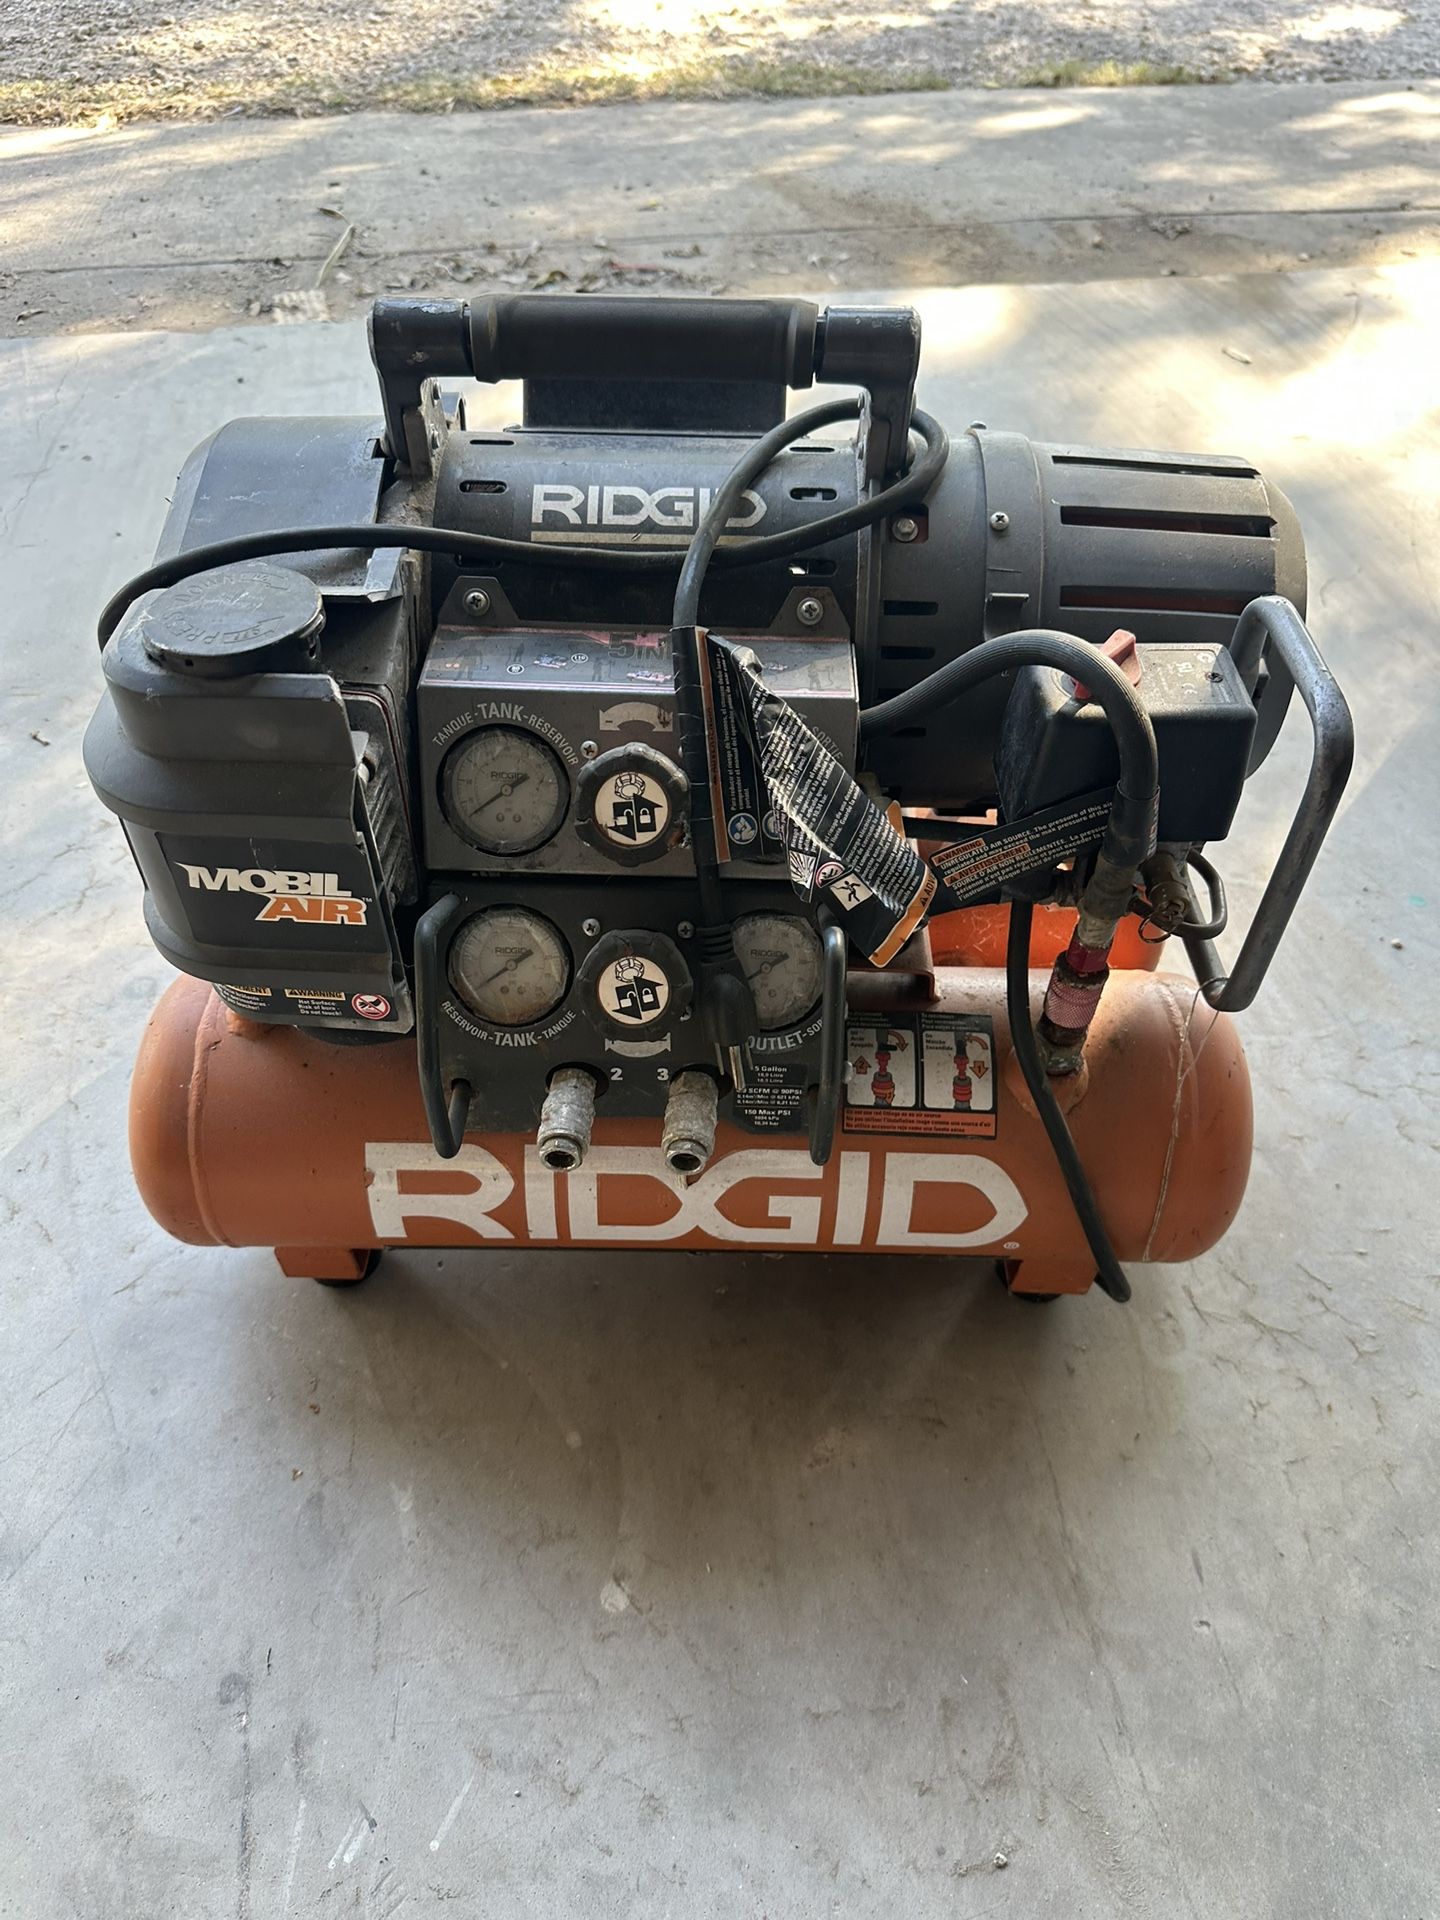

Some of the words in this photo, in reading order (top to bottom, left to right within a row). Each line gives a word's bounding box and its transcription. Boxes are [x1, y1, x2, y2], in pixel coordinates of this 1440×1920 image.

[940, 844, 989, 870] UNREGULATED
[989, 839, 1002, 849] AIR
[1033, 823, 1047, 833] The
[1047, 812, 1078, 829] pressure
[974, 851, 988, 861] and
[1028, 832, 1041, 840] the
[1056, 815, 1087, 831] pressure
[174, 862, 352, 897] MOBIL
[951, 873, 978, 890] SOURCE
[997, 857, 1015, 869] NON
[255, 893, 367, 926] AIR
[610, 1067, 624, 1081] 2
[657, 1067, 669, 1081] 3
[363, 1142, 1029, 1249] RIDGID
